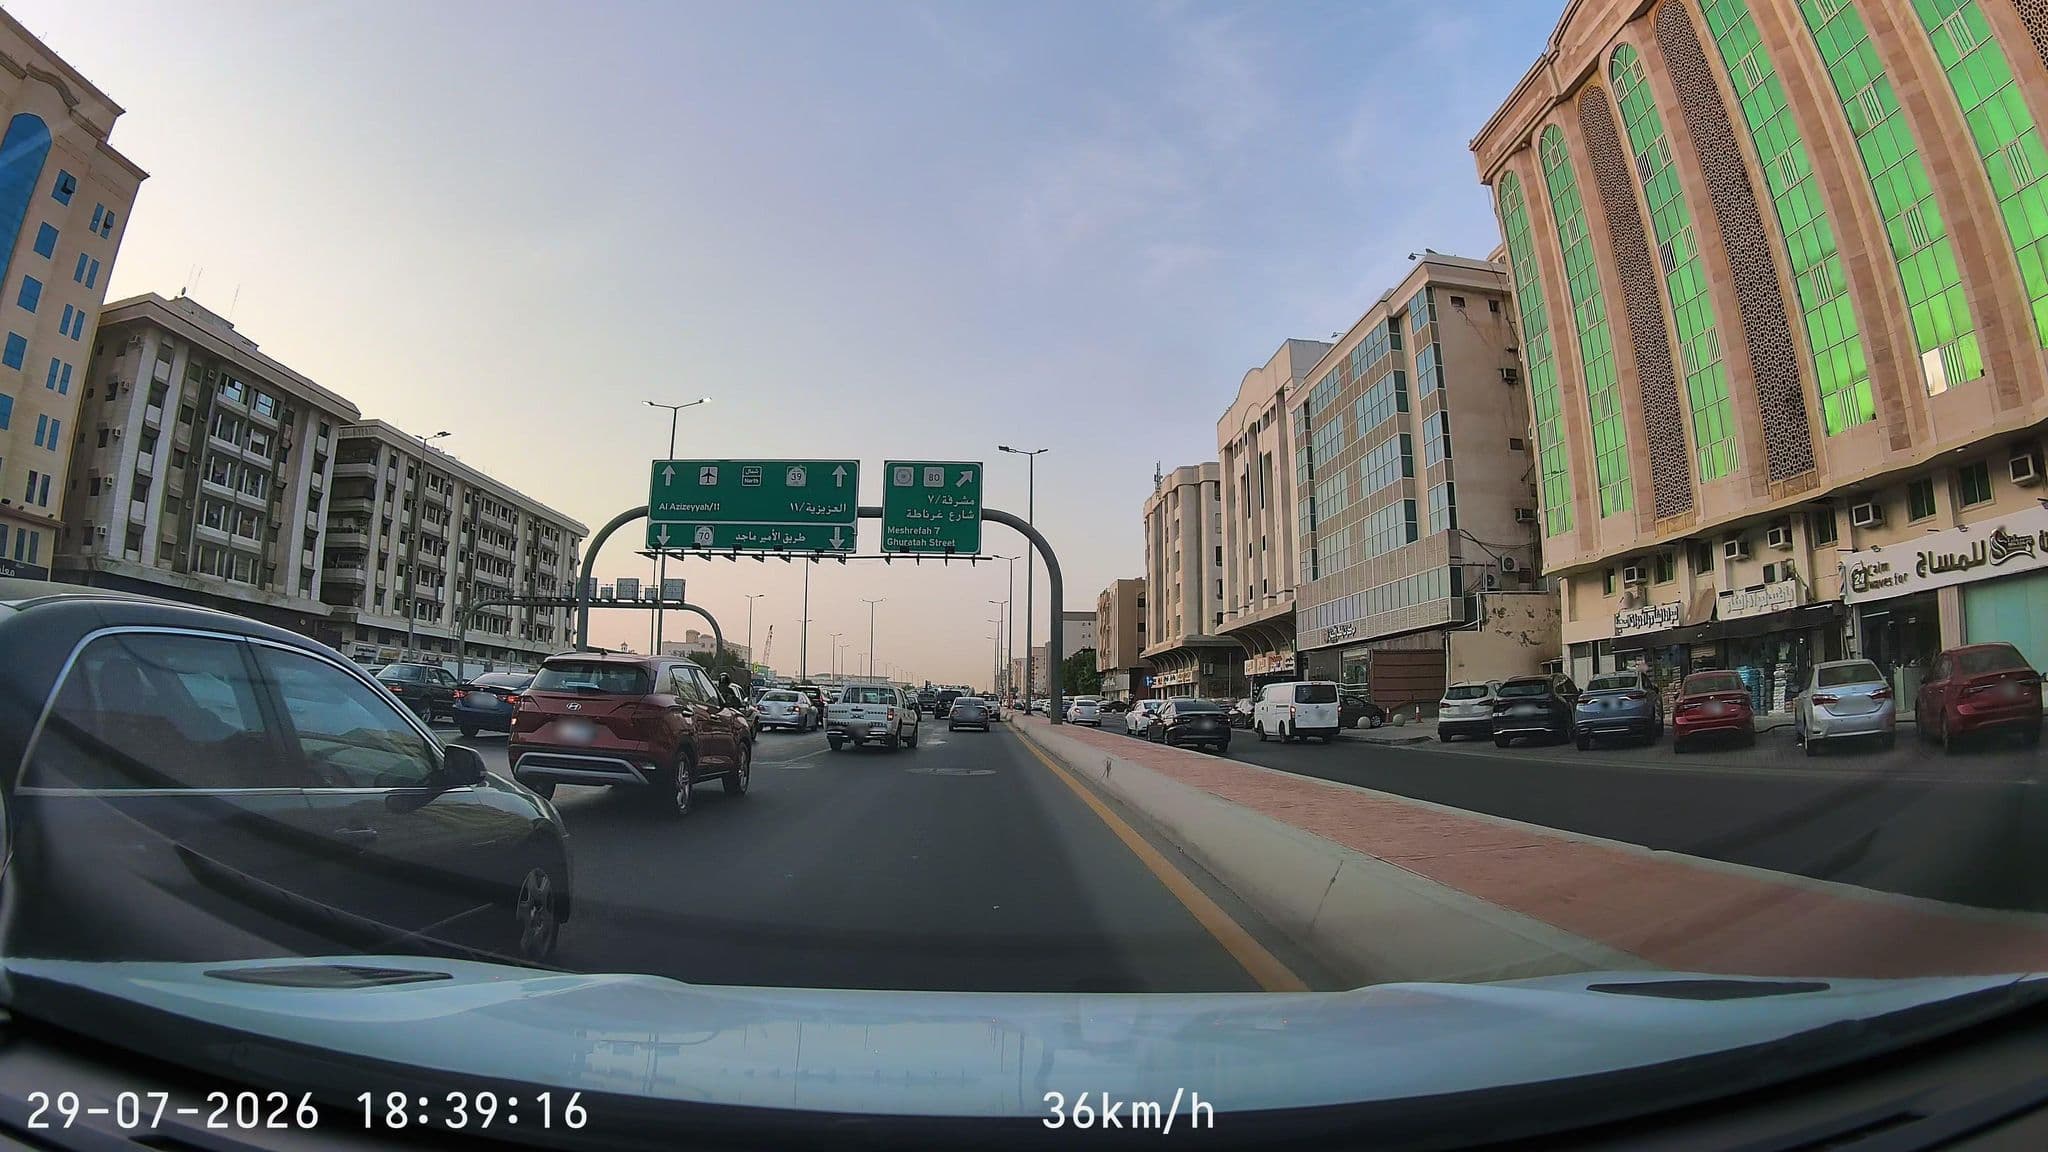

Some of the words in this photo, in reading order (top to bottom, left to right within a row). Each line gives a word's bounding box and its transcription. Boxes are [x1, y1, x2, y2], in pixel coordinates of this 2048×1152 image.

[791, 473, 801, 481] 39
[658, 502, 668, 511] Al
[949, 509, 975, 522] شارع
[887, 526, 932, 535] Meshrefah
[934, 527, 941, 535] 7
[699, 532, 710, 540] 70
[735, 531, 757, 542] ماجد
[782, 532, 806, 544] طريق
[929, 539, 956, 547] Street
[1916, 539, 1987, 579] للمساج
